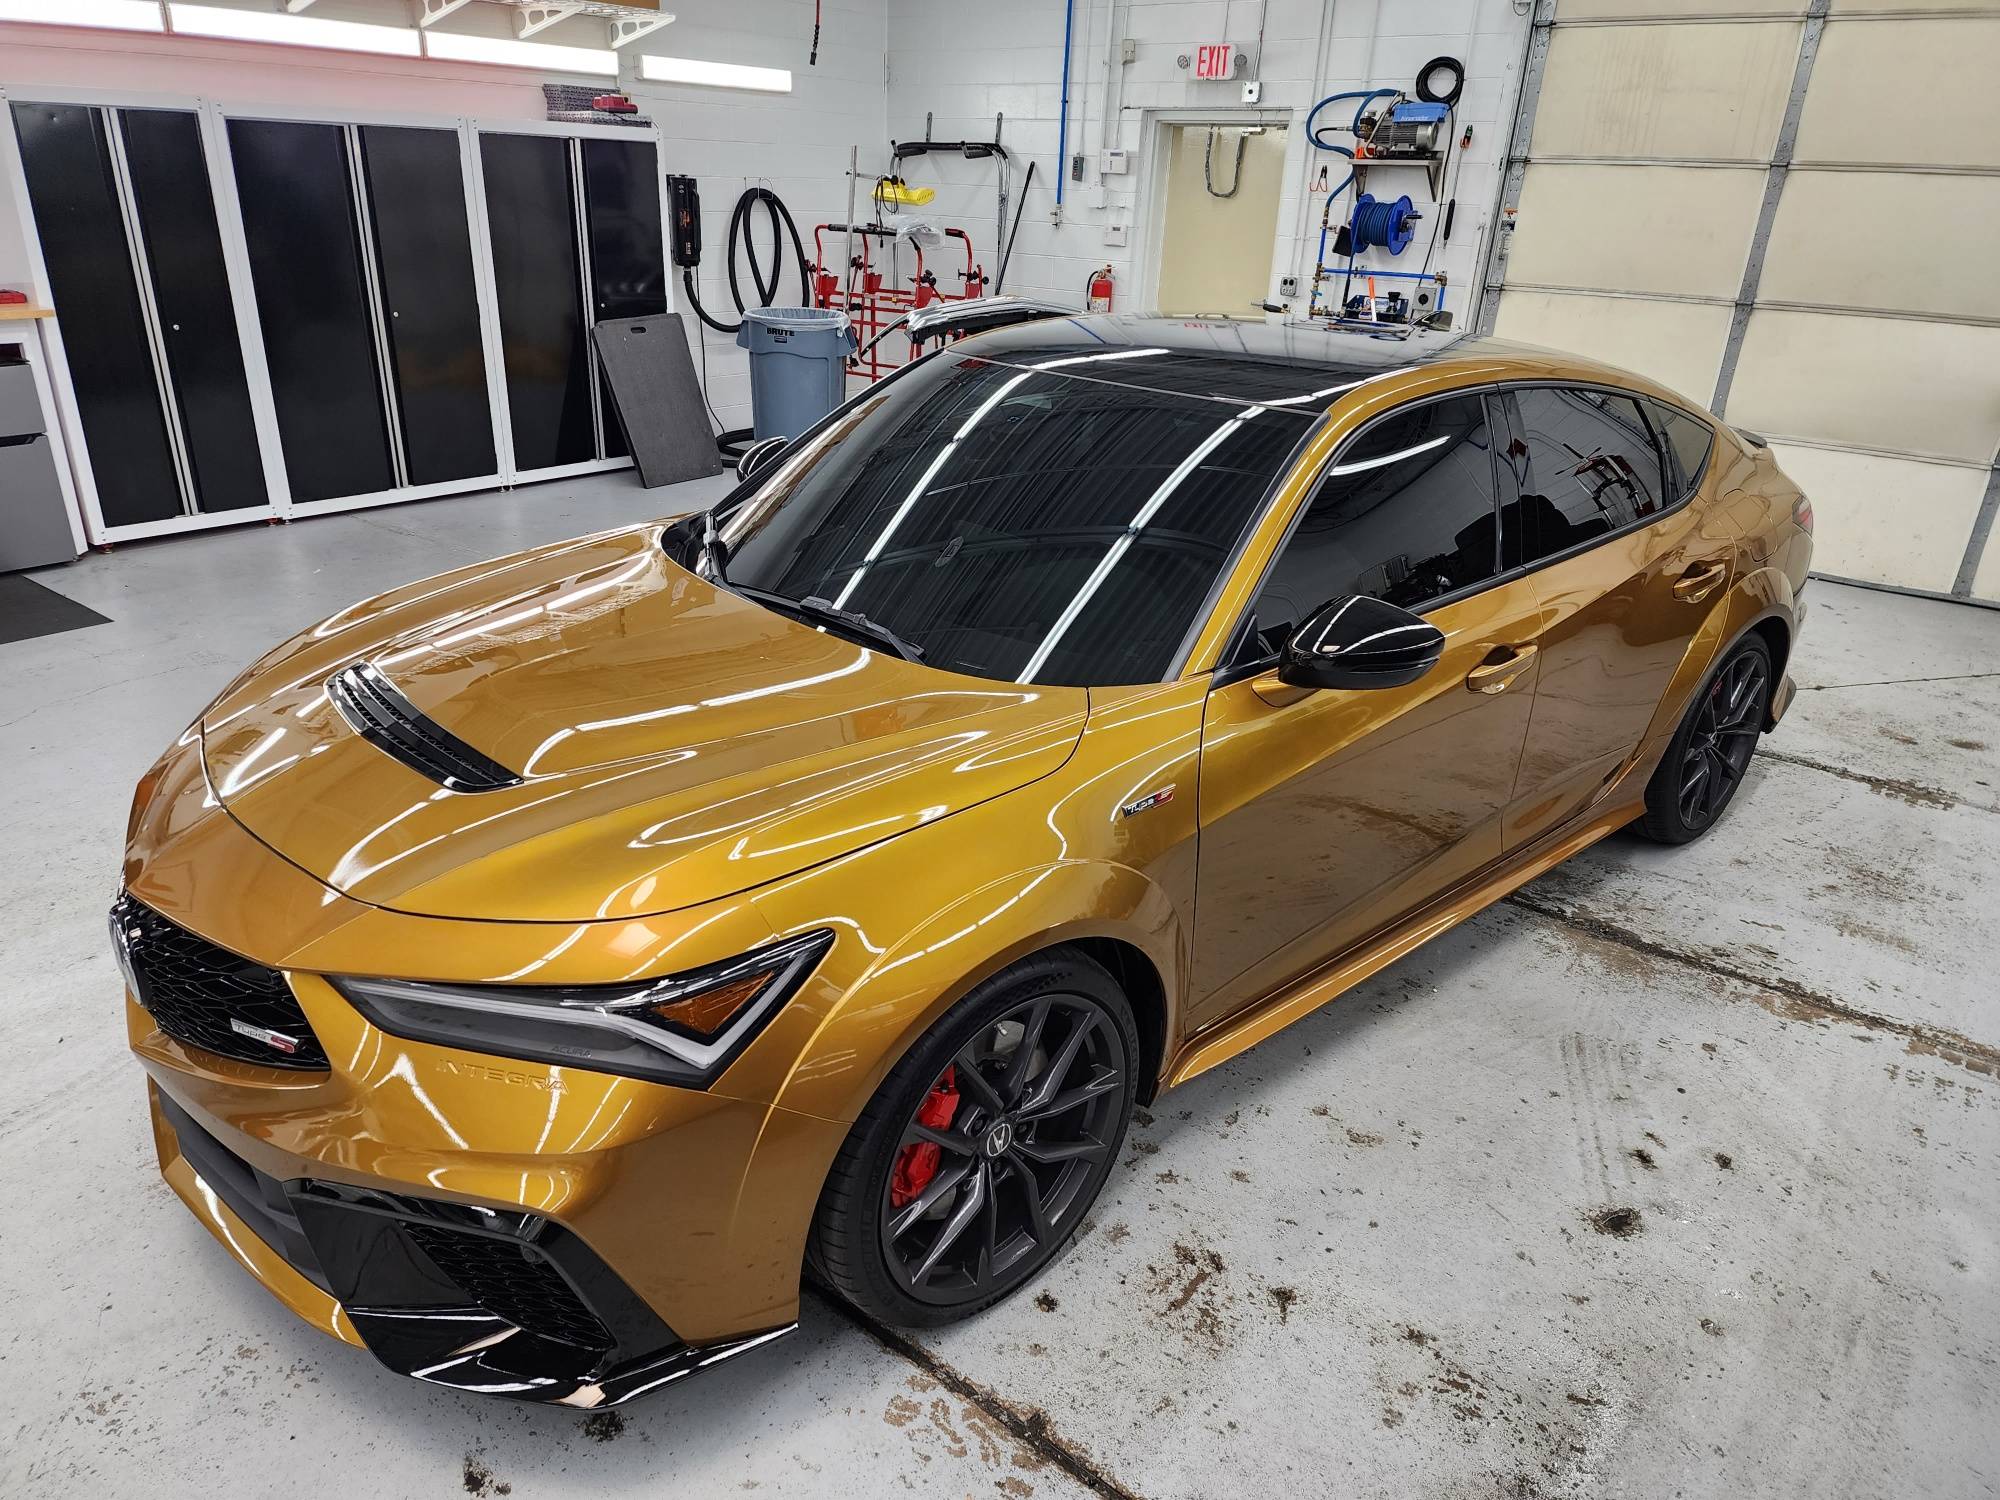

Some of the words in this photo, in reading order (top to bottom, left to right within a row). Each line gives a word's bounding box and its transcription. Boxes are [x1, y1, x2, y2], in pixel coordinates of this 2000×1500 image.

[1197, 46, 1231, 76] EXIT
[766, 327, 795, 337] BRUTE
[268, 1034, 295, 1054] S
[436, 1058, 570, 1096] INTEGRA
